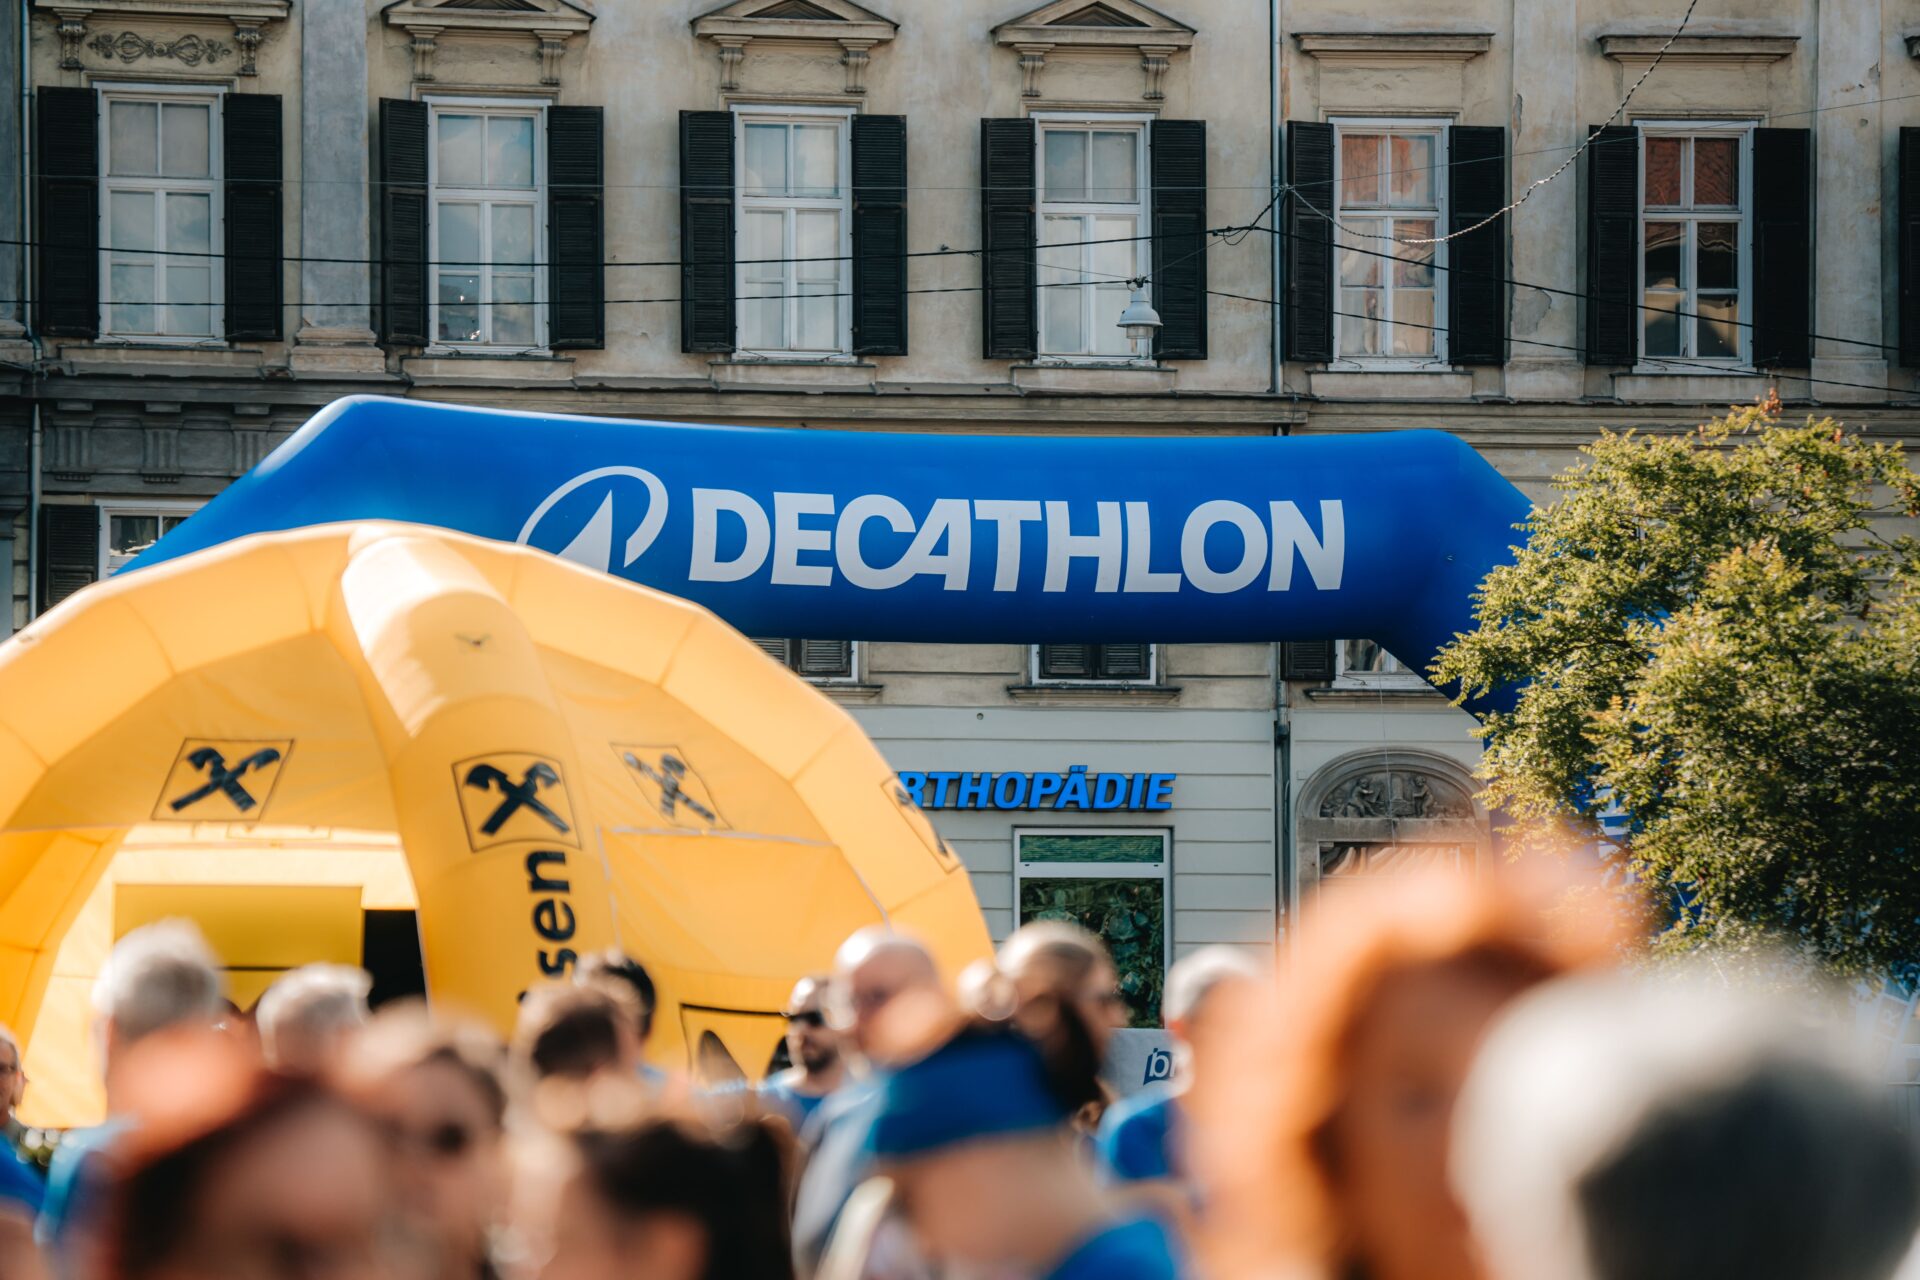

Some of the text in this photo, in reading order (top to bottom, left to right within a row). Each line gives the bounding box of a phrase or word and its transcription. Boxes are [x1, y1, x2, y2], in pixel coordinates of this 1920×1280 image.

[688, 488, 1346, 594] DECATHLON
[898, 764, 1175, 810] RTHOPÄDIE
[518, 850, 577, 1001] sen
